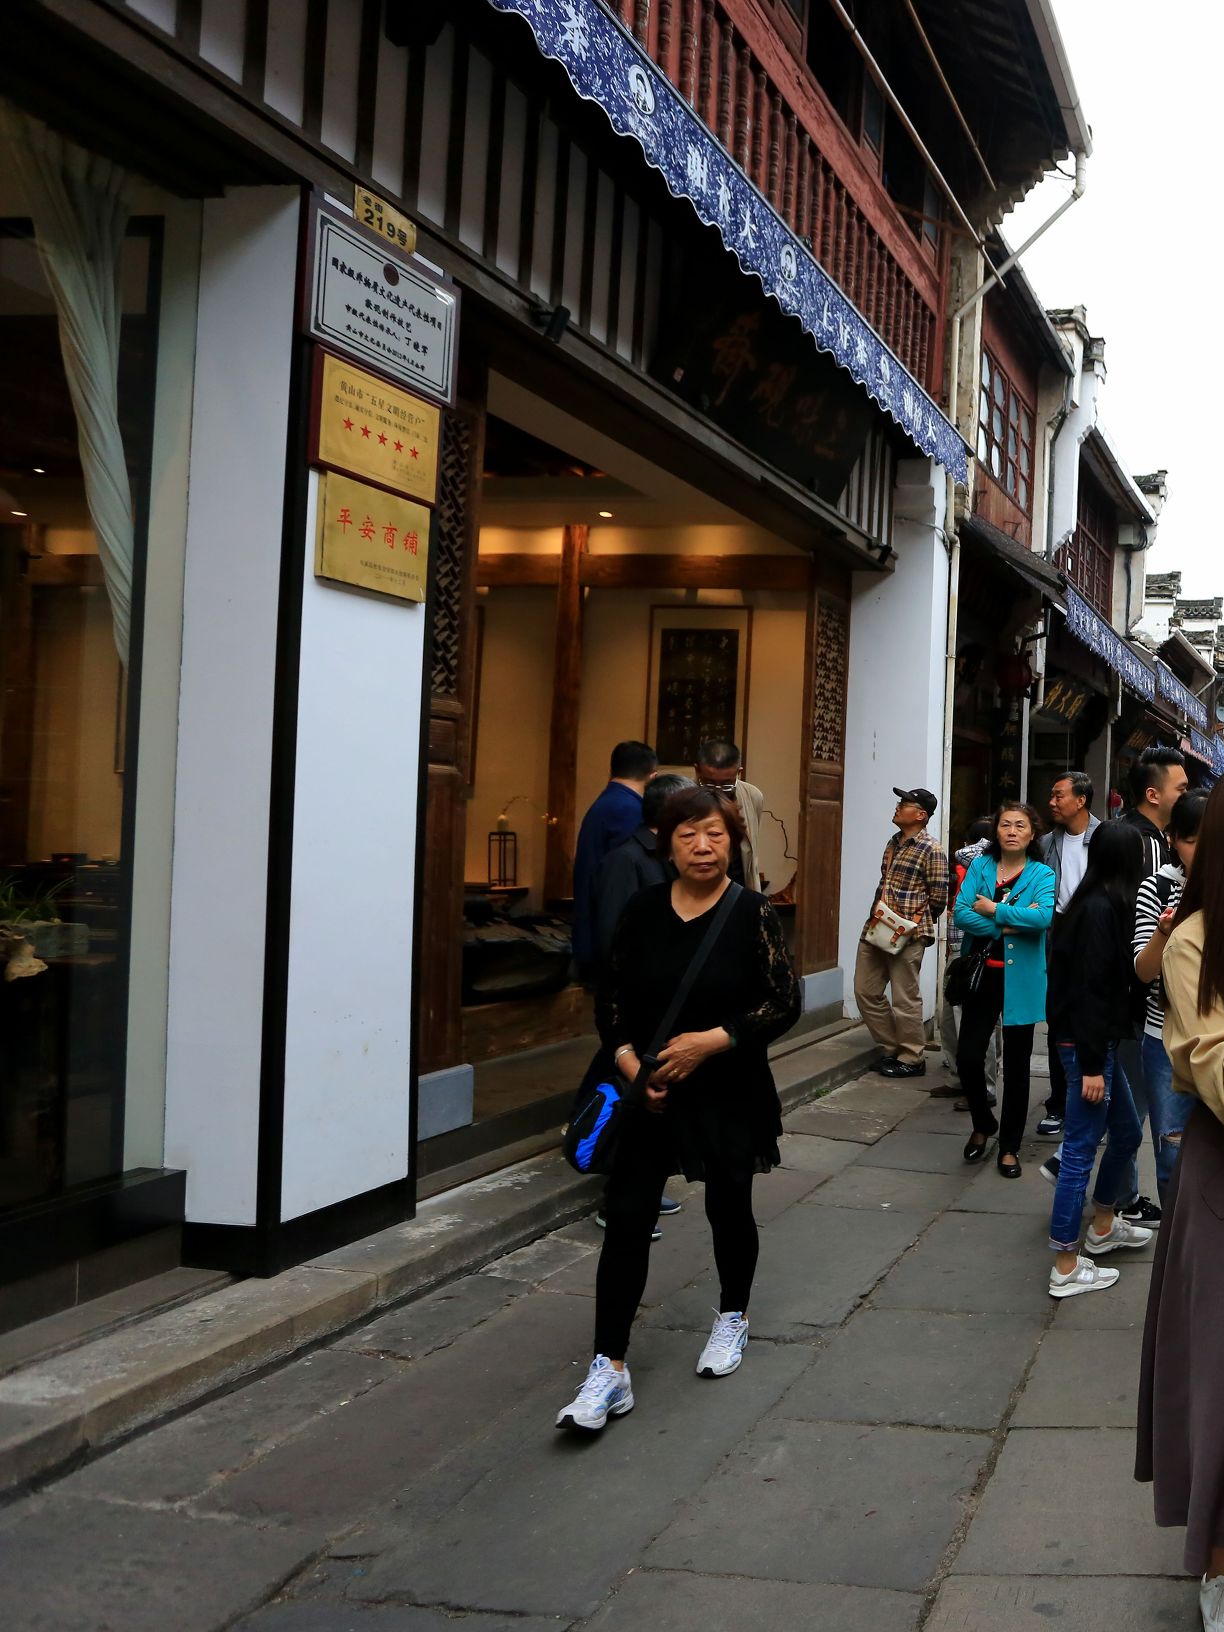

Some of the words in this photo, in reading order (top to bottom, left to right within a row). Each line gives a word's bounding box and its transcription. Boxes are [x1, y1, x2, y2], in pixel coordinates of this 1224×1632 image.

[362, 194, 384, 214] 老街
[363, 208, 408, 247] 219号
[336, 508, 419, 556] 平安商铺
